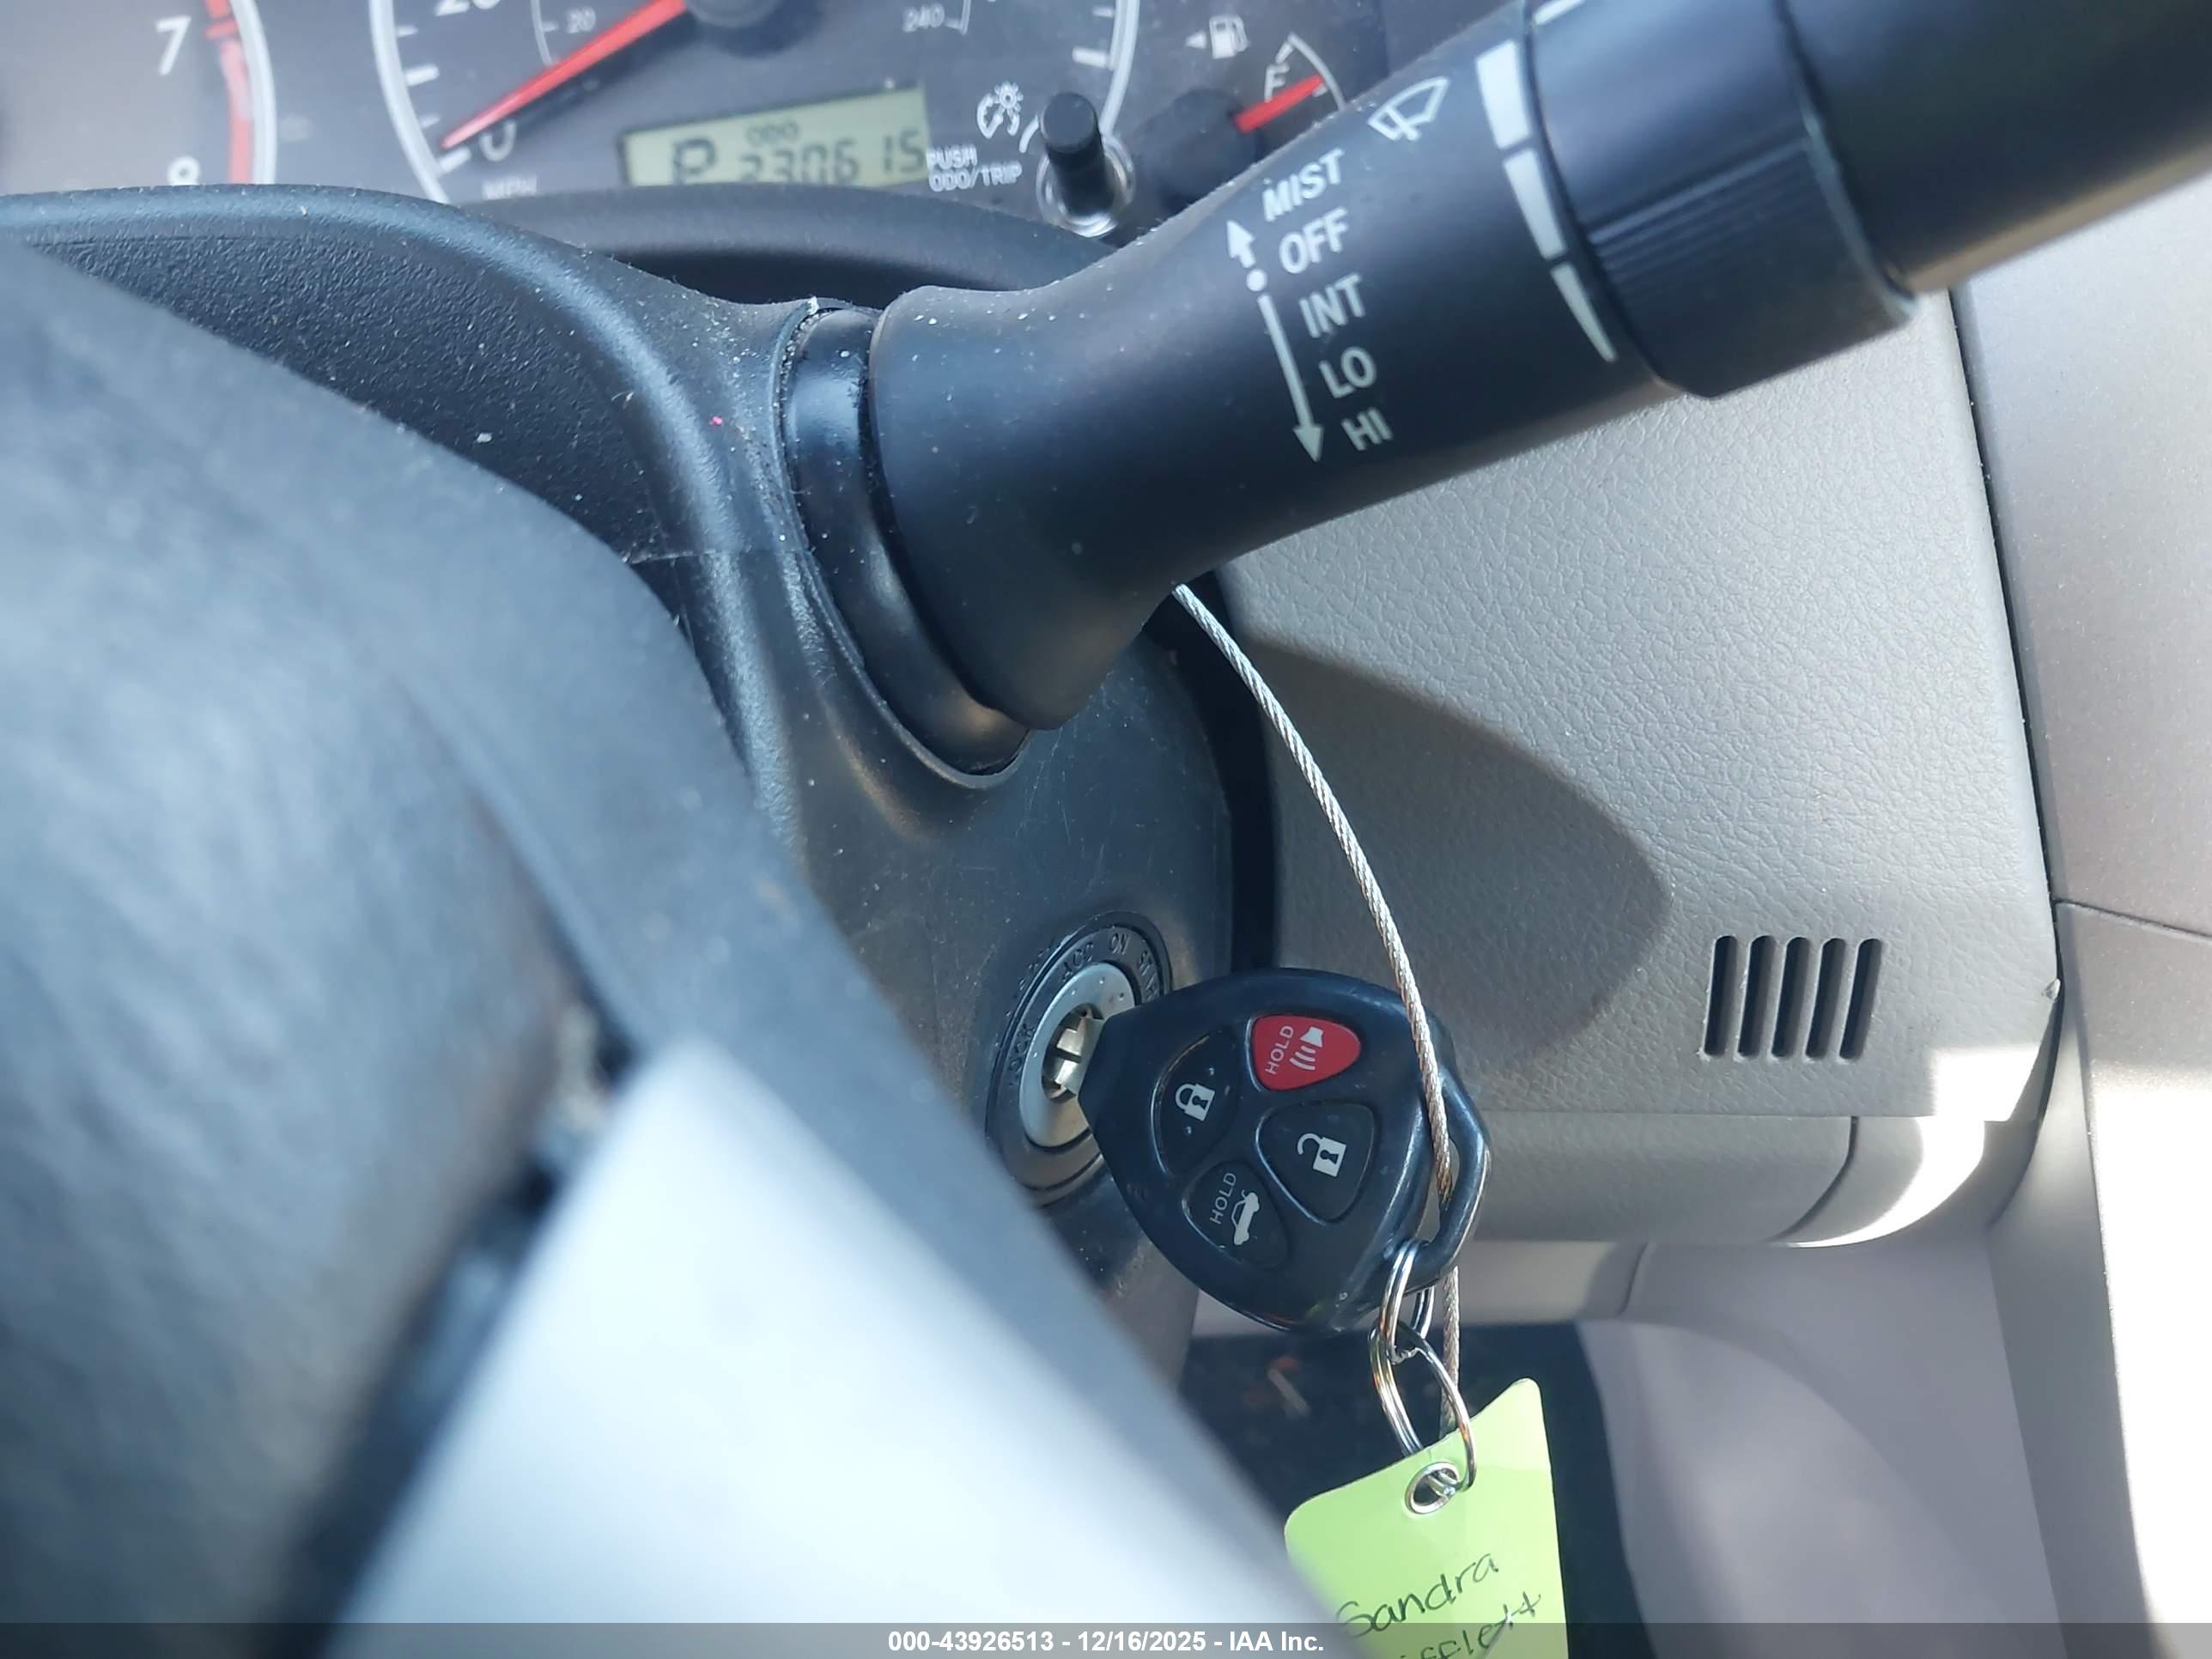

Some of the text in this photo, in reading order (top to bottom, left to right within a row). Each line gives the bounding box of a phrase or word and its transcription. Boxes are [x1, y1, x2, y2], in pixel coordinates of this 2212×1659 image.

[155, 15, 191, 76] 7
[1264, 64, 1290, 102] F
[672, 137, 717, 184] P
[926, 143, 977, 170] PUSH
[928, 161, 1023, 192] ODO/TRIP
[1262, 149, 1344, 222] MIST
[1279, 207, 1349, 274] OFF
[1299, 274, 1365, 338] INT
[1319, 347, 1376, 398] LO
[1341, 409, 1394, 451] HI
[1264, 1024, 1294, 1075] HOLD
[1209, 1172, 1237, 1225] HOLD
[1335, 1553, 1499, 1638] Sandra
